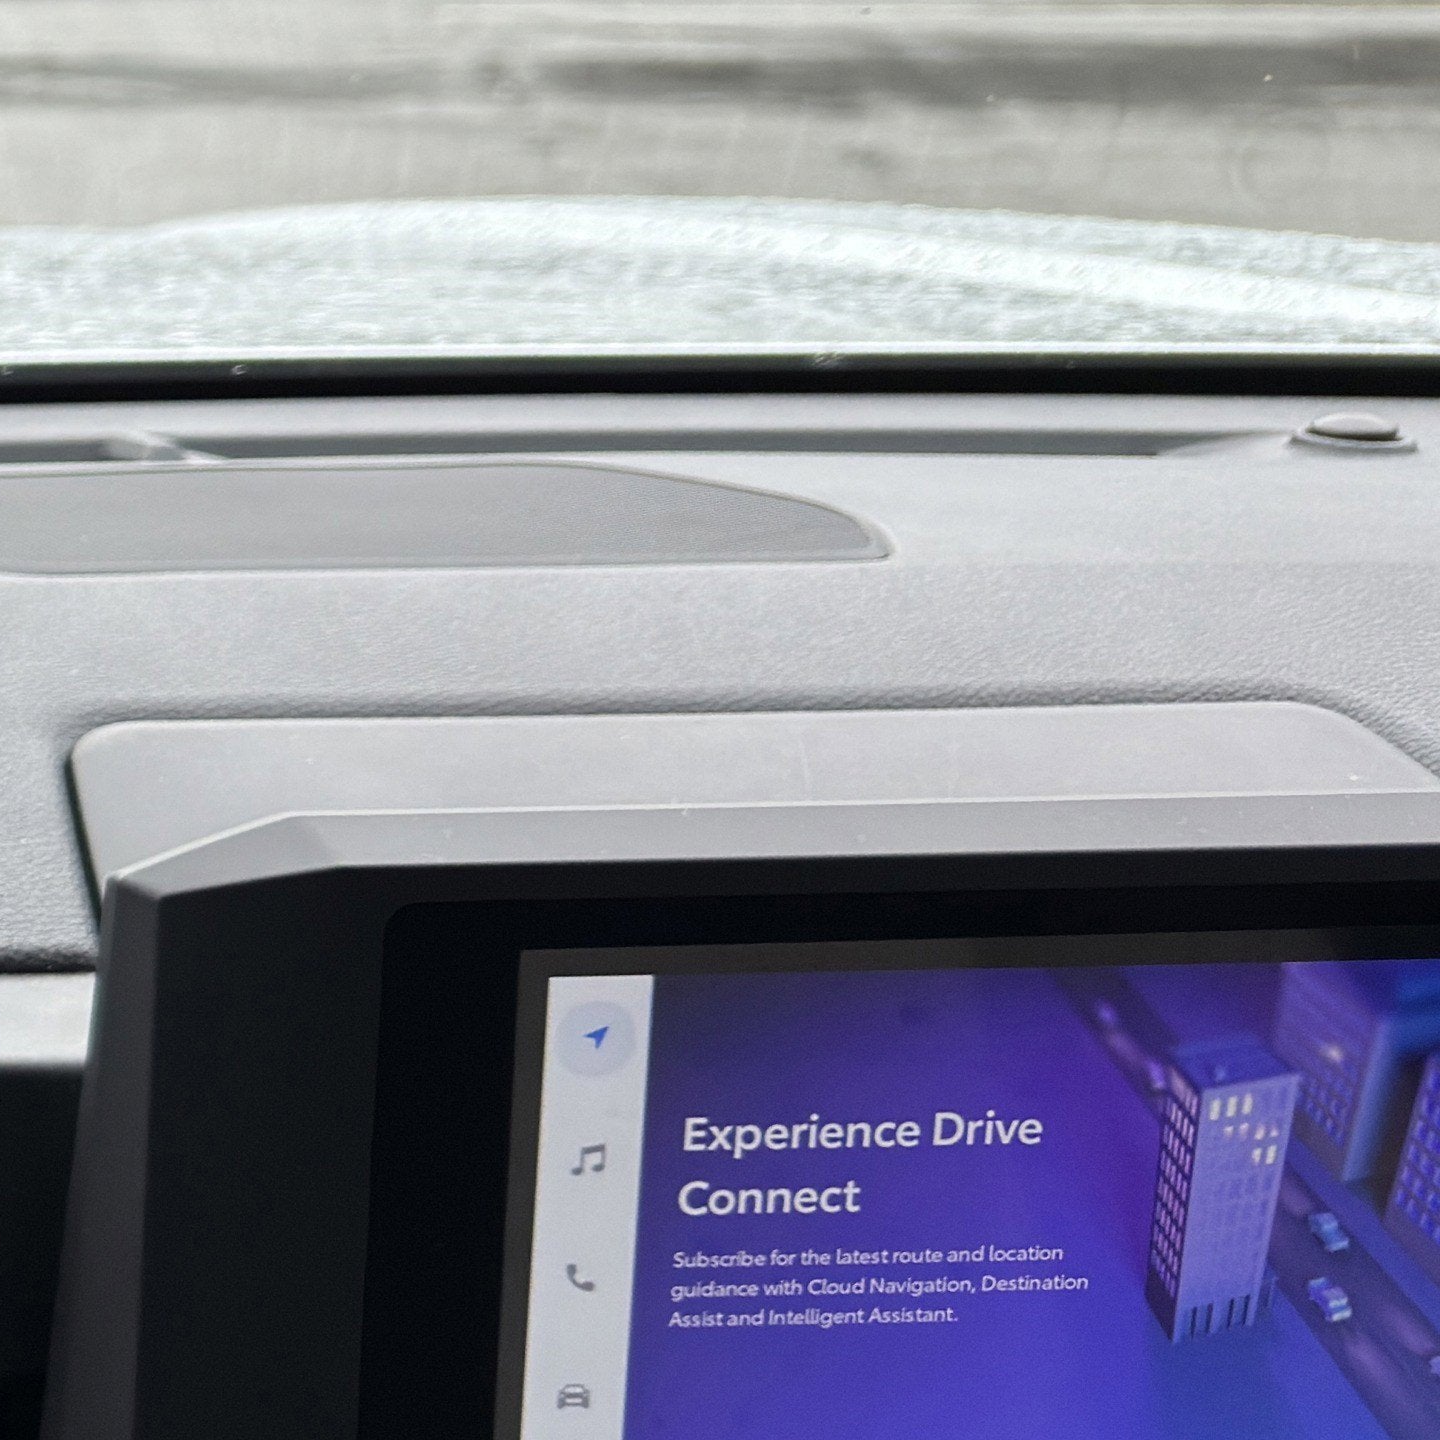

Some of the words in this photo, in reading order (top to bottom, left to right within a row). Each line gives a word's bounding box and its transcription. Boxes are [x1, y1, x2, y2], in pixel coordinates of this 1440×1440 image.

[683, 1113, 921, 1159] Experience
[932, 1110, 1043, 1147] Drive
[678, 1179, 861, 1217] Connect
[673, 1250, 766, 1269] Subscribe
[770, 1249, 797, 1267] for
[800, 1248, 831, 1267] the
[836, 1247, 889, 1266] latest
[892, 1247, 943, 1264] route
[946, 1245, 985, 1263] and
[989, 1244, 1064, 1262] location
[670, 1281, 759, 1301] guidance
[763, 1279, 803, 1297] with
[808, 1277, 865, 1296] Cloud
[869, 1276, 976, 1298] Navigation,
[981, 1274, 1089, 1292] Destination
[668, 1311, 723, 1328] Assist
[727, 1310, 765, 1327] and
[768, 1308, 865, 1329] Intelligent
[869, 1306, 959, 1325] Assistant.
